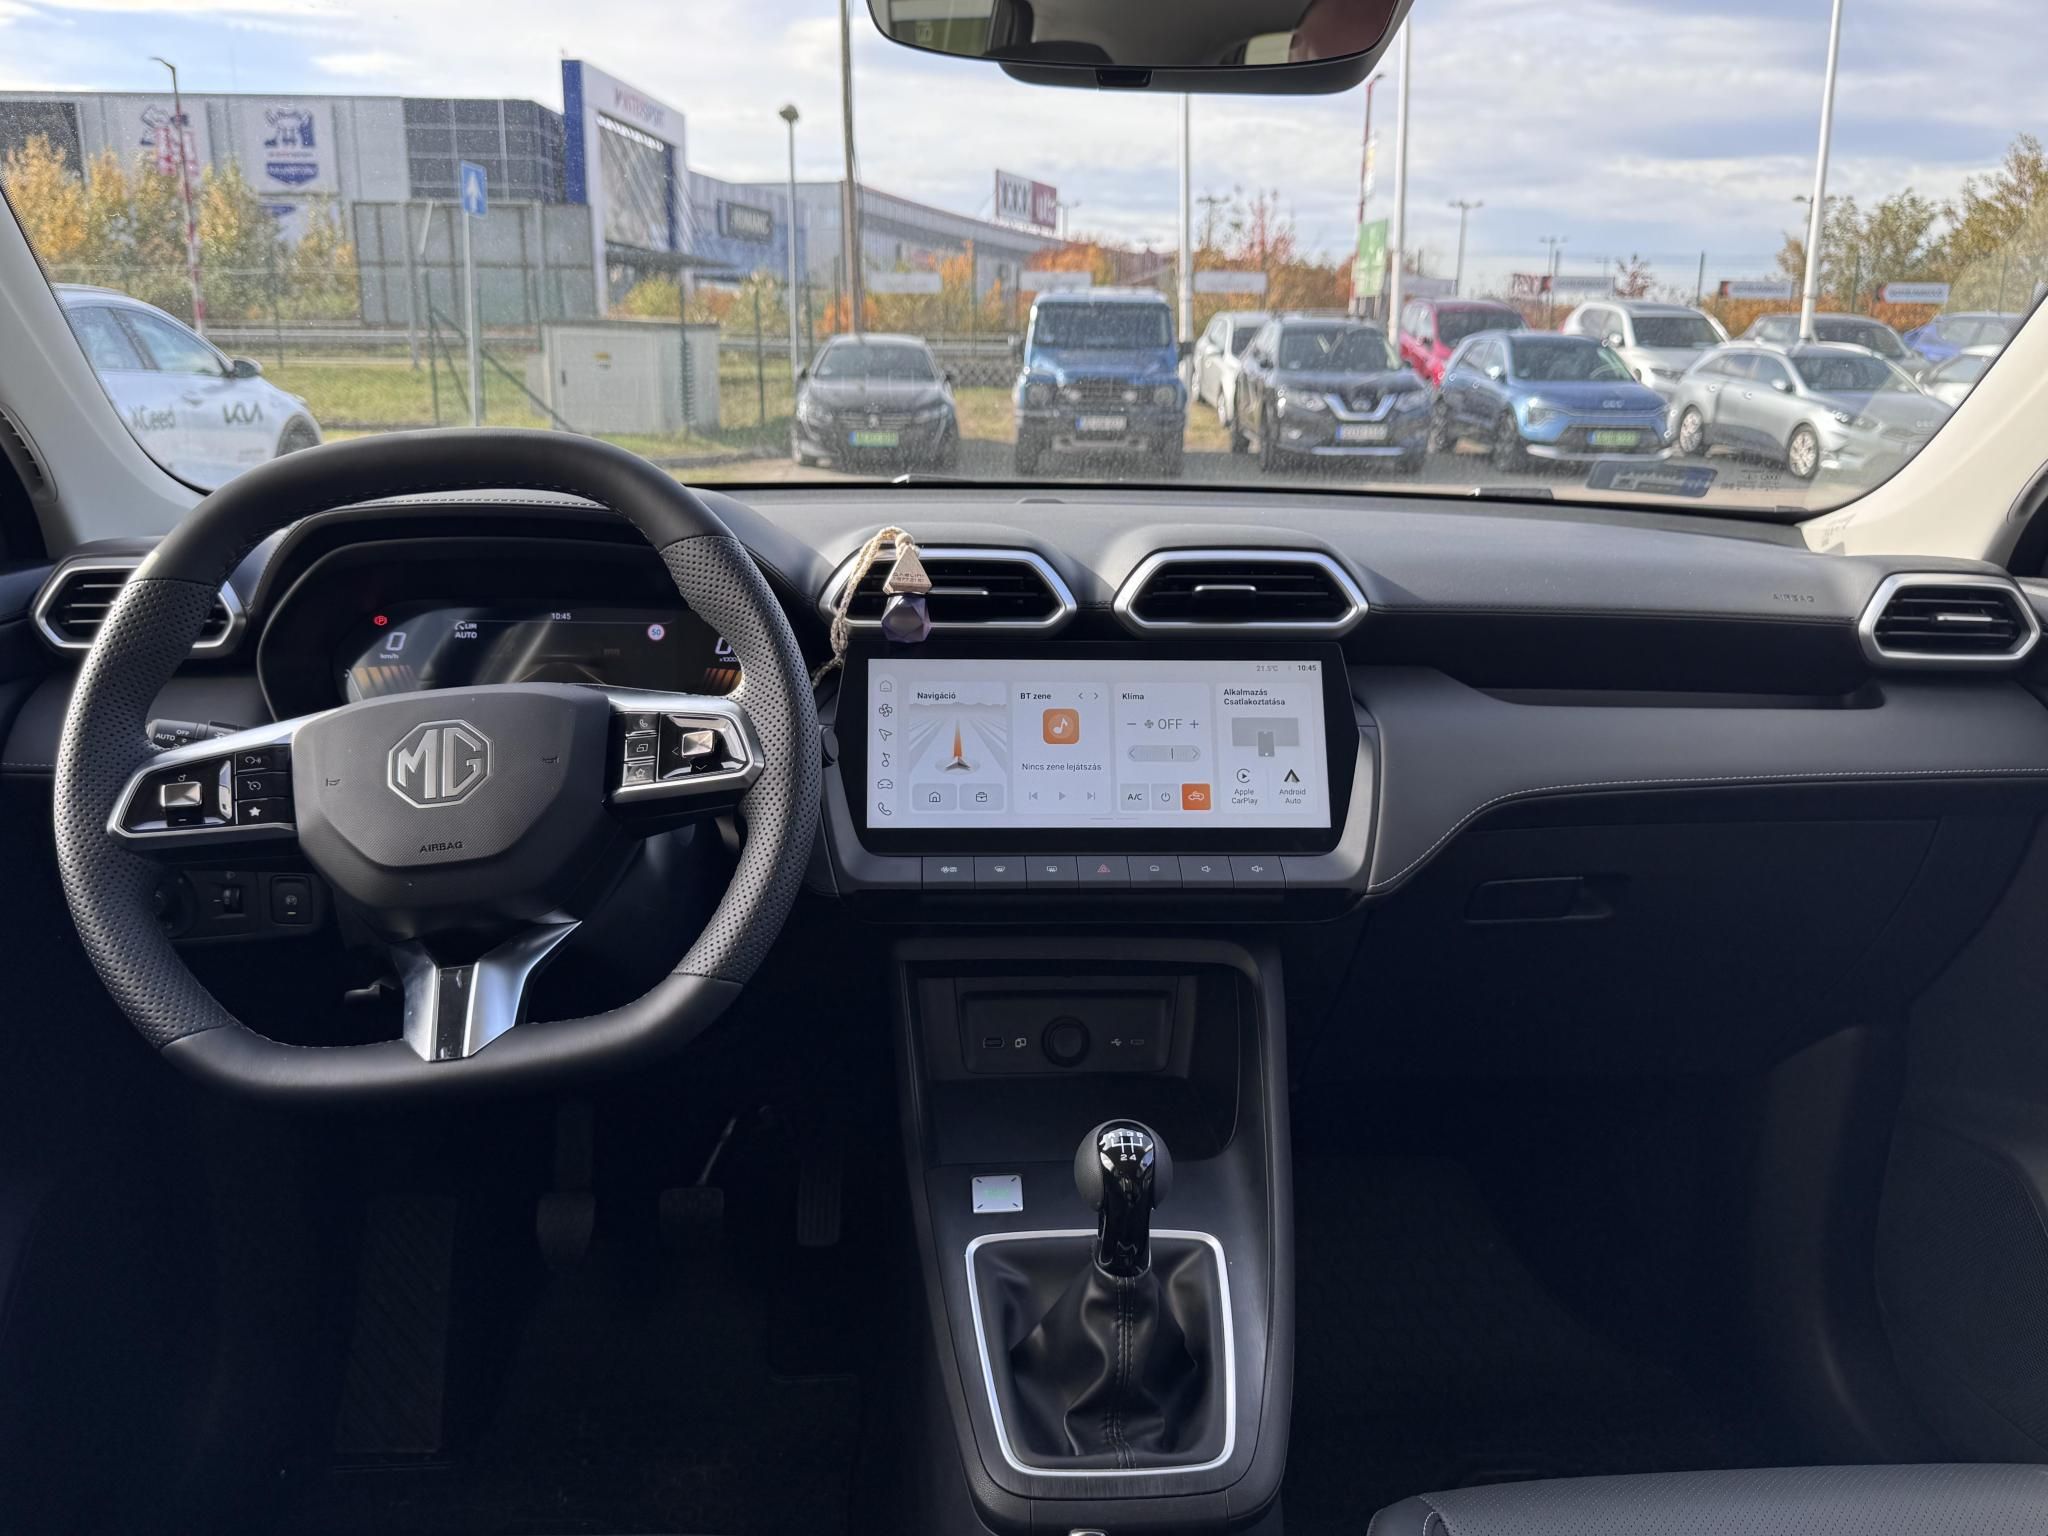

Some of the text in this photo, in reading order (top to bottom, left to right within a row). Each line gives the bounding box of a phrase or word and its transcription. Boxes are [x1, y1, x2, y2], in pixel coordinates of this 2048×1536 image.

[551, 612, 572, 621] 10:45
[454, 631, 477, 639] AUTO
[651, 627, 662, 637] 50
[917, 691, 956, 700] Navigáció
[1020, 692, 1032, 700] BT
[1223, 688, 1268, 696] Alkalmazás
[1223, 698, 1286, 706] Csatlakoztatása
[1157, 718, 1183, 730] OFF
[155, 733, 176, 741] AUTO
[397, 727, 482, 799] MG
[1022, 762, 1045, 771] Nincs
[1066, 762, 1102, 772] lejátszás
[1279, 788, 1306, 796] Android
[1127, 793, 1143, 801] A/C
[1231, 797, 1258, 805] CarPlay
[419, 841, 463, 853] AIRBAG
[1120, 1153, 1137, 1161] 2 4
